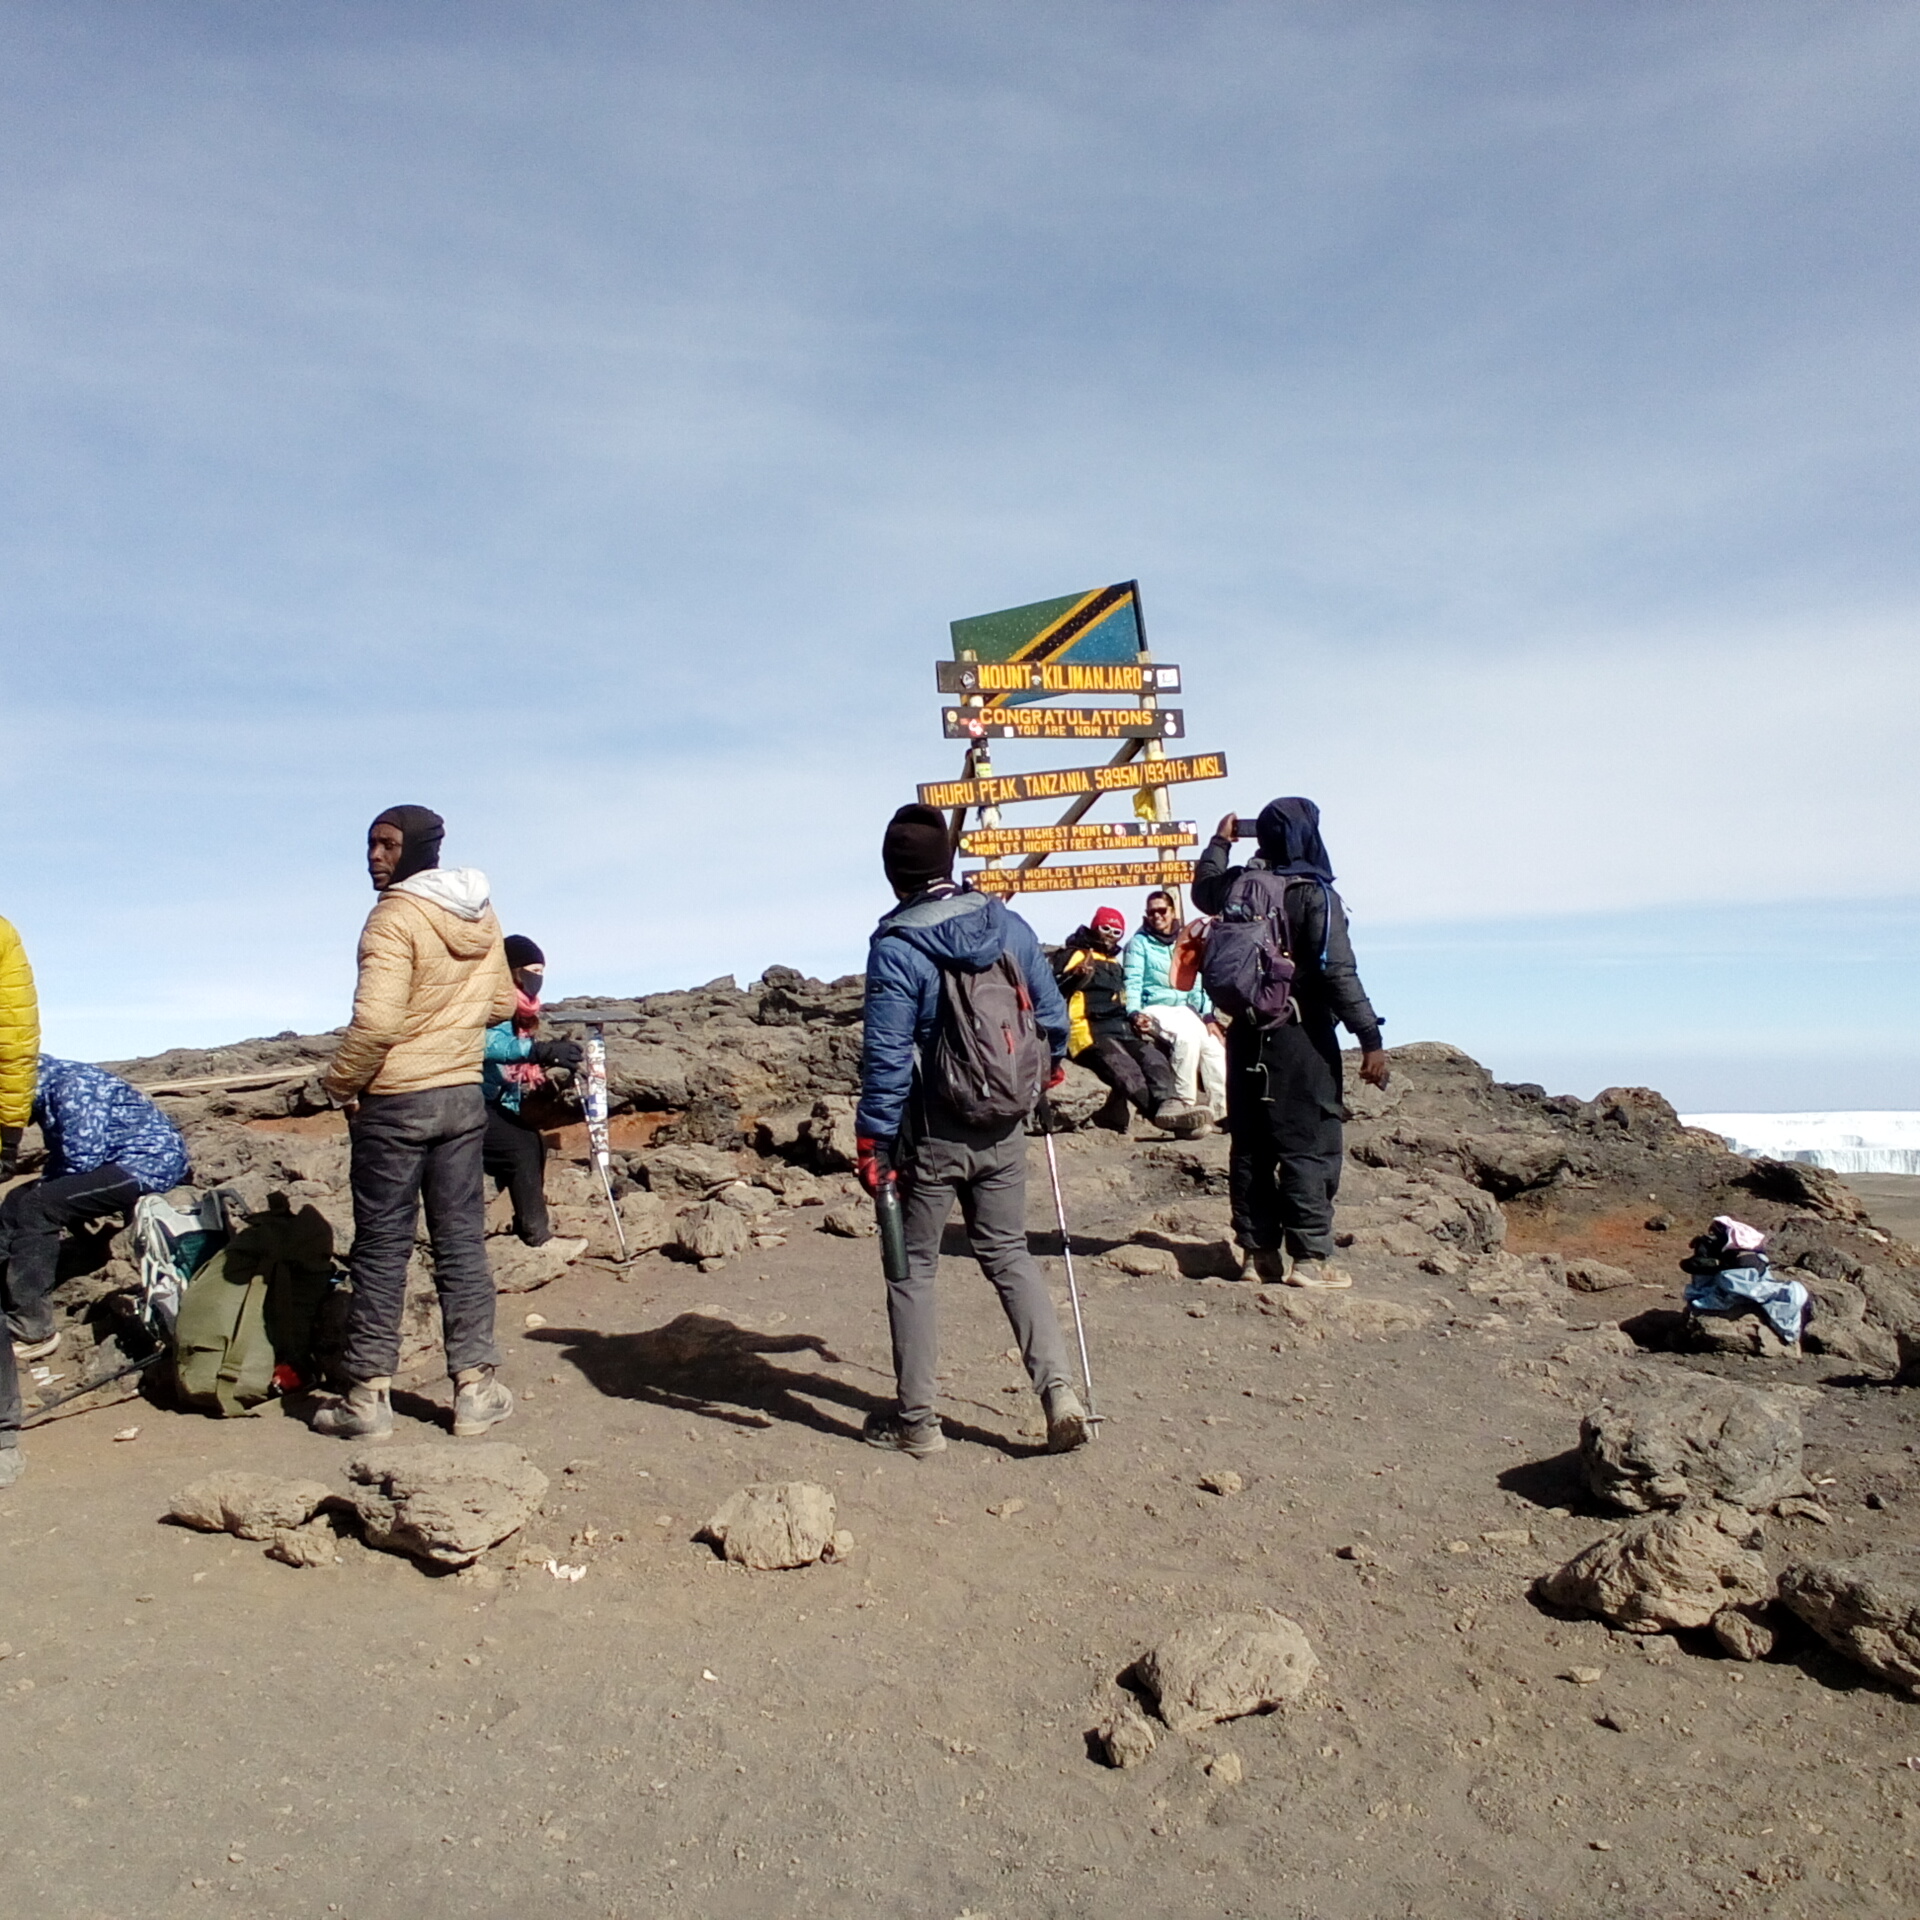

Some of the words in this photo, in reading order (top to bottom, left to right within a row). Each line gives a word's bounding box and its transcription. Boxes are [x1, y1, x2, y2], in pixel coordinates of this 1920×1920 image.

[977, 665, 1032, 689] MOUNT
[1042, 665, 1142, 690] KILIMANJARO
[980, 709, 1154, 725] CONGRATULATIONS
[1017, 726, 1039, 736] YOU
[1044, 726, 1067, 736] ARE
[1074, 726, 1102, 737] NOW
[1107, 726, 1121, 737] AT
[923, 782, 975, 806] UHURU
[1193, 756, 1224, 778] AMSL
[1023, 826, 1068, 840] HIGHEST
[1071, 825, 1102, 837] POINT
[1023, 838, 1068, 852] HIGHEST
[1147, 833, 1194, 846] MOUNTAIN
[1008, 869, 1020, 880] OF
[1073, 864, 1121, 877] LARGEST
[1126, 861, 1188, 874] VOLCANOES
[1023, 878, 1074, 891] HERITAGE
[1076, 877, 1095, 888] AND
[1145, 874, 1159, 884] OF
